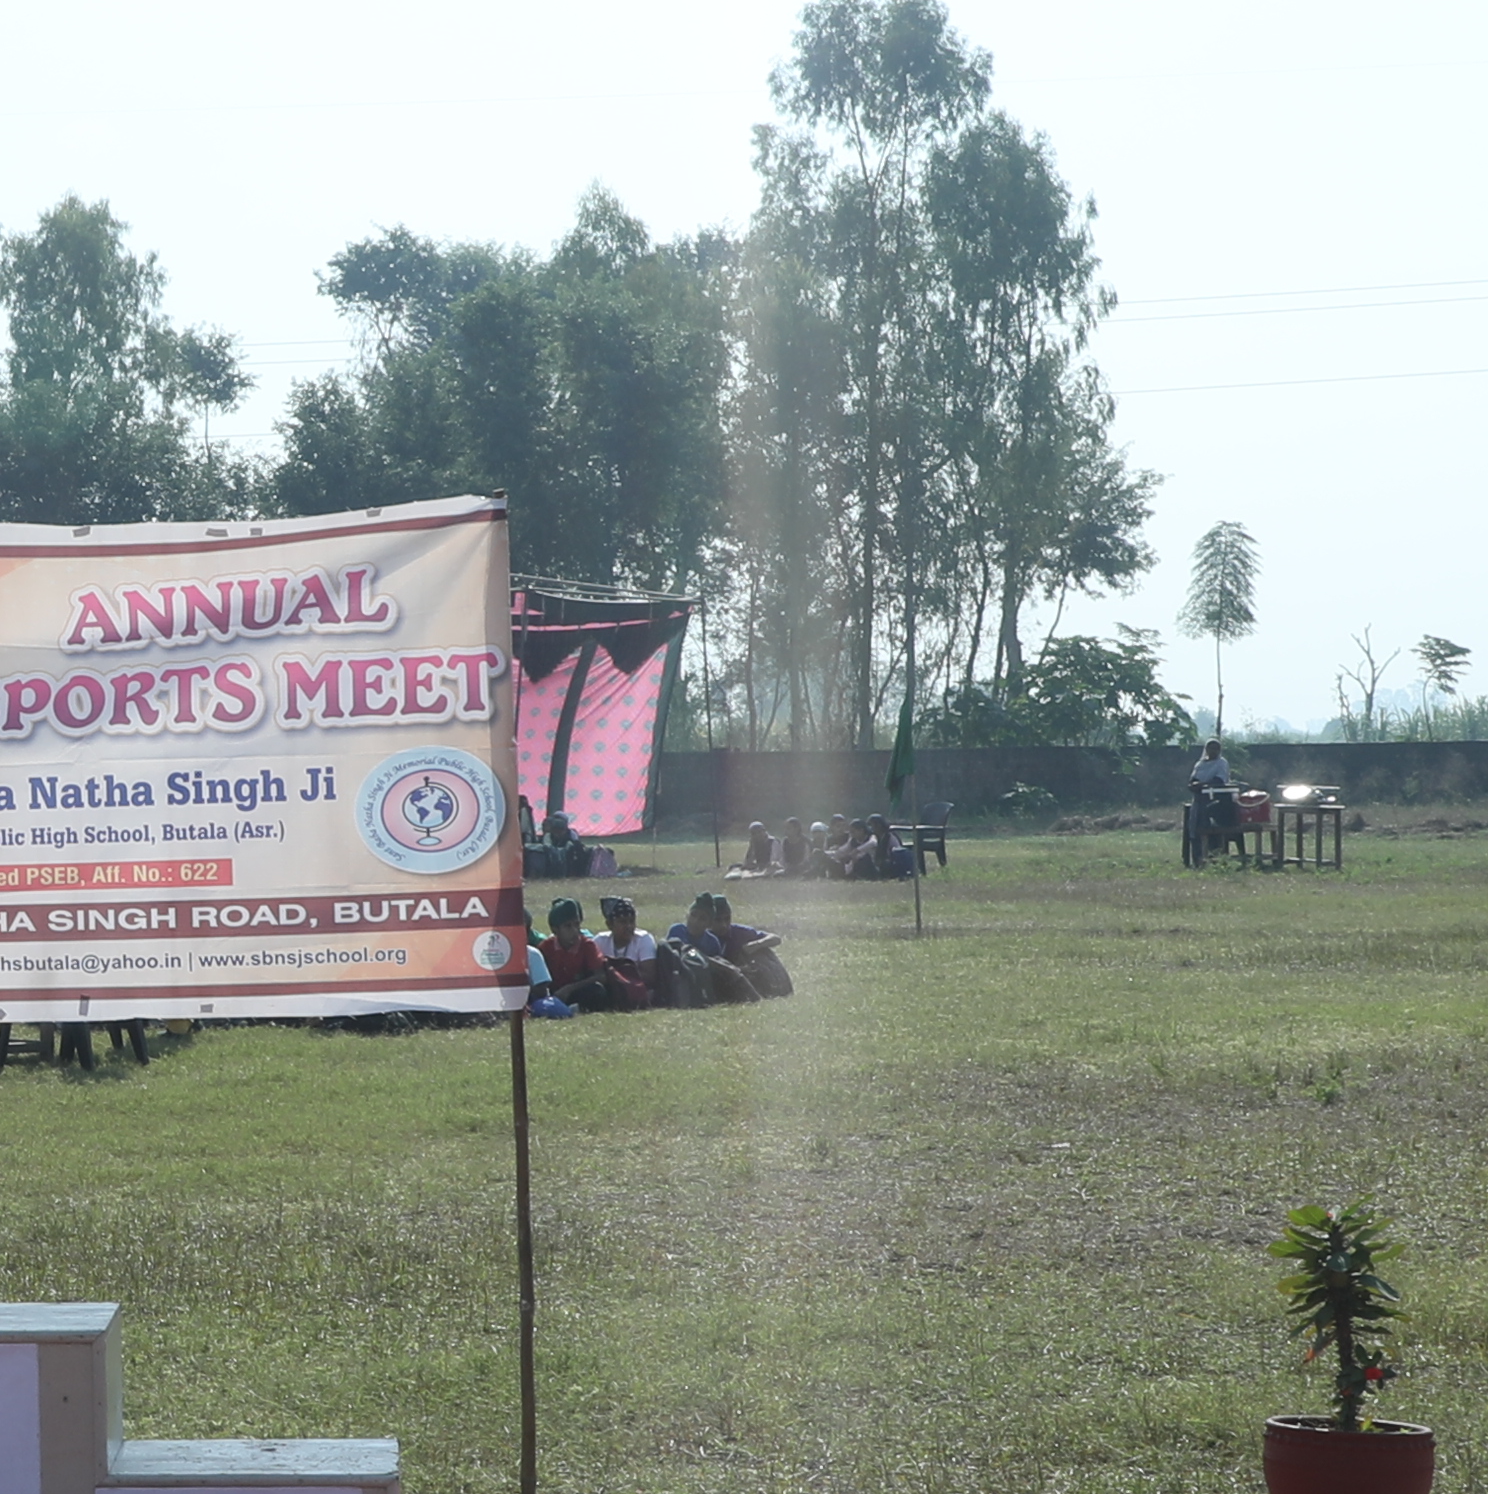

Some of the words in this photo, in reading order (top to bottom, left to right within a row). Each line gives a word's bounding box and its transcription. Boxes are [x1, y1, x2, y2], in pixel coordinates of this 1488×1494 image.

[67, 569, 390, 645] ANNUAL
[282, 652, 498, 720] MEET
[29, 775, 155, 810] Natha
[167, 770, 287, 811] Singh
[300, 767, 336, 801] Ji
[31, 826, 79, 849] High
[84, 824, 156, 845] School,
[162, 822, 228, 841] Butala
[234, 820, 285, 843] (Asr.)
[26, 866, 85, 887] PSEB,
[92, 865, 125, 884] Aff.
[133, 863, 174, 883] No.:
[180, 862, 218, 882] 622
[47, 906, 177, 933] SINGH
[191, 903, 320, 929] ROAD,
[333, 896, 490, 924] BUTALA
[198, 947, 407, 970] www.sbnsjschool.org
